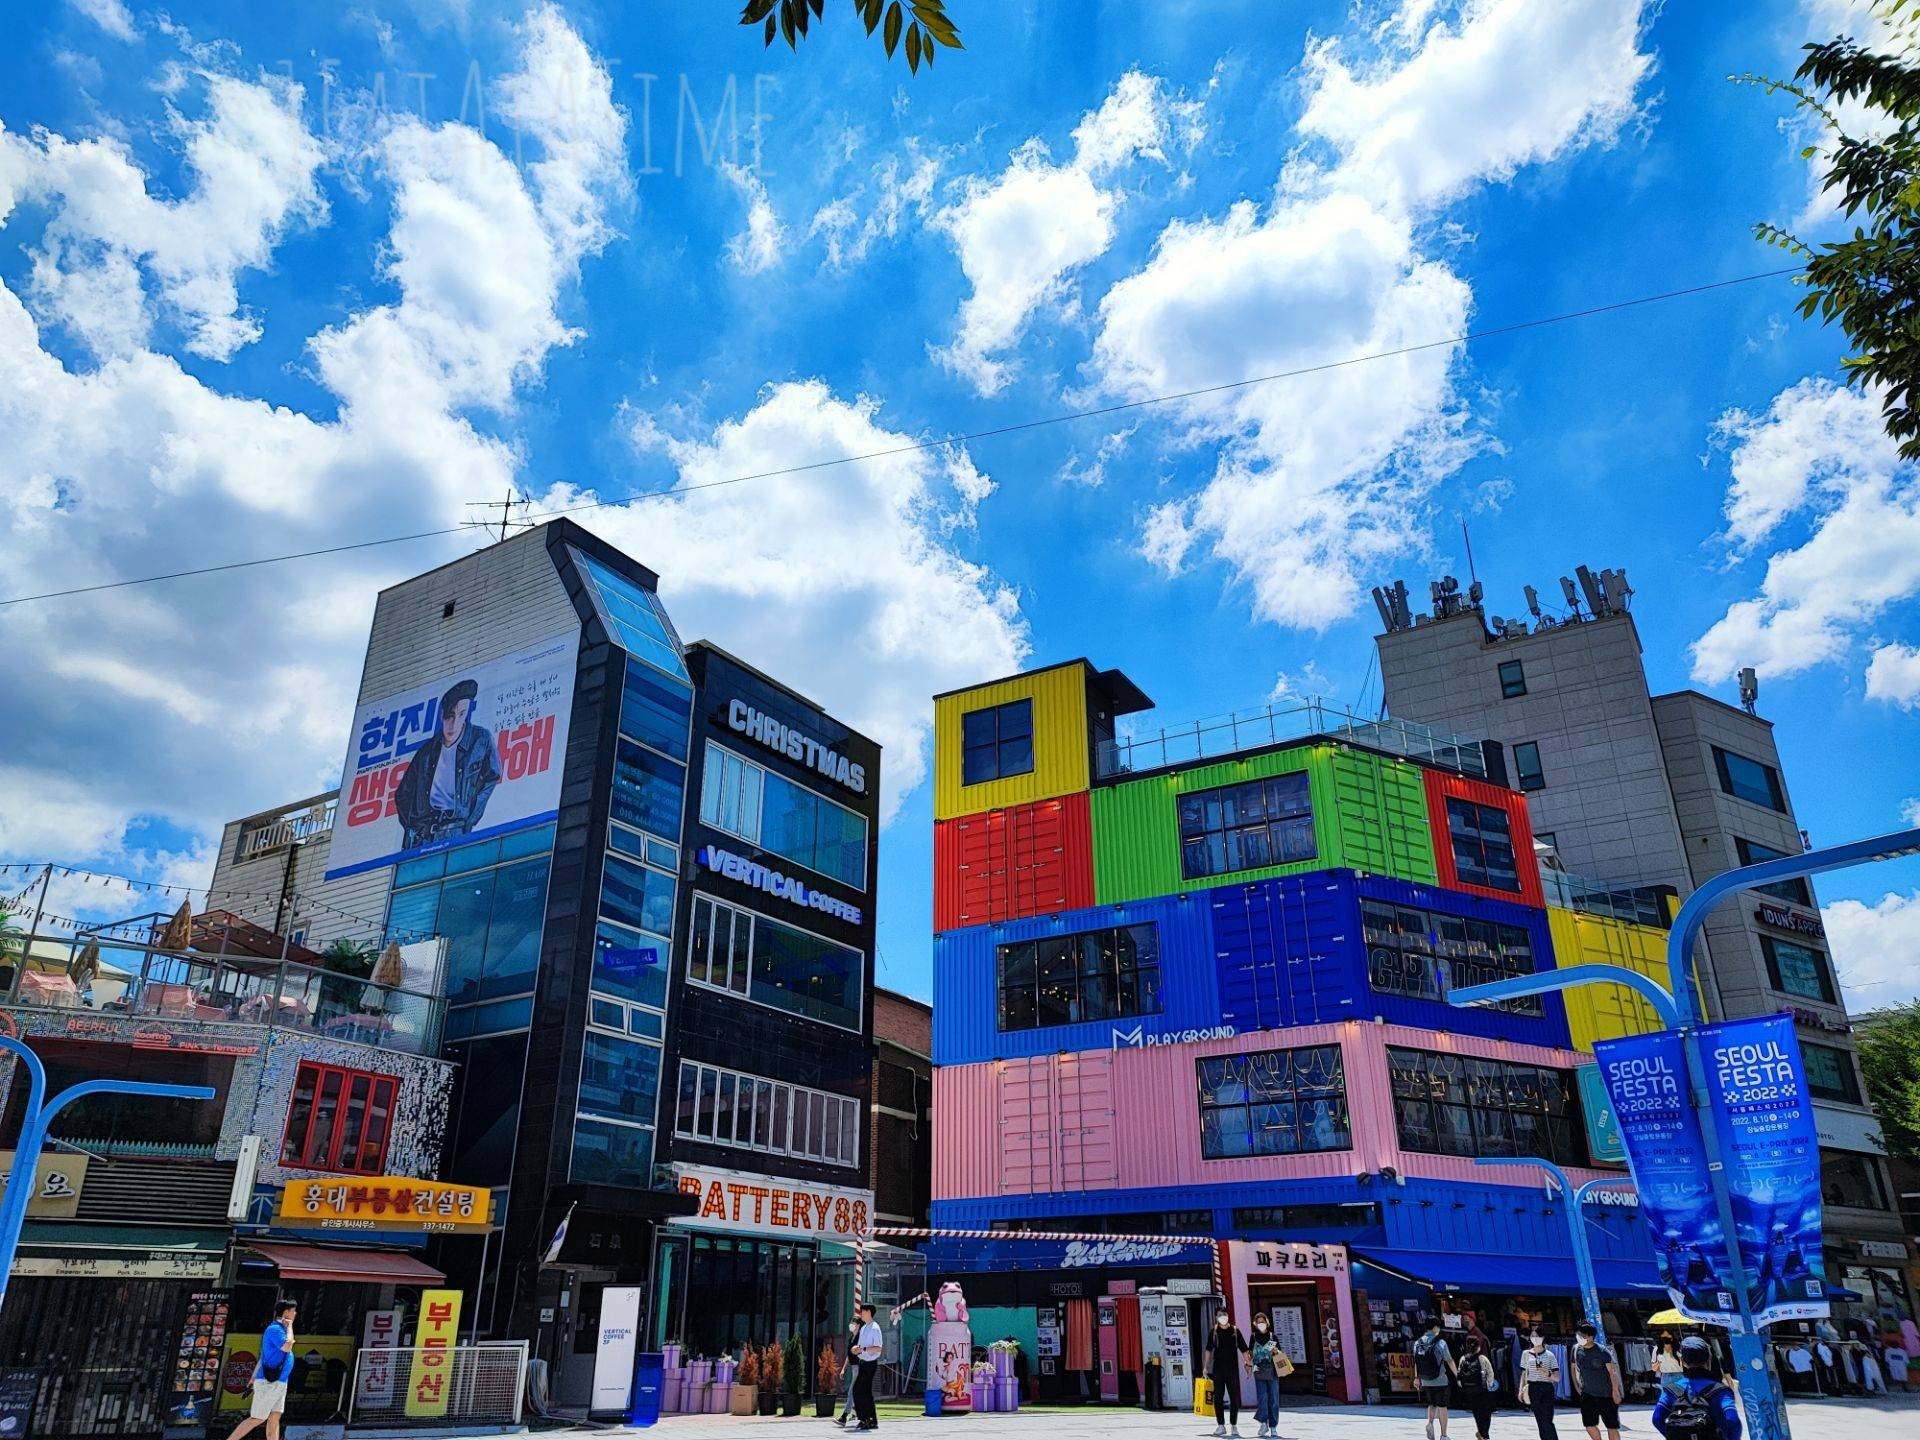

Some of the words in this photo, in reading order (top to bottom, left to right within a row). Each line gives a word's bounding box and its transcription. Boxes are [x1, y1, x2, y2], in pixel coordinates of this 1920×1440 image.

[706, 844, 810, 908] VERTICAL
[808, 889, 862, 926] COFFEE
[66, 1018, 121, 1034] BEERFUL
[1146, 1025, 1236, 1047] PLAYGROUND
[1713, 1040, 1789, 1067] SEOUL
[1608, 1055, 1674, 1082] SEOUL
[1718, 1062, 1795, 1089] FESTA
[1612, 1075, 1678, 1099] FESTA
[1743, 1086, 1779, 1103] 2022
[1629, 1097, 1663, 1112] 2022
[1730, 1142, 1759, 1152] SEOUL
[303, 1184, 477, 1218] 홍대부동산컨설팅
[422, 1221, 456, 1232] 337-1472
[1255, 1250, 1329, 1270] 파쿠모리
[416, 1302, 452, 1403] 부동산
